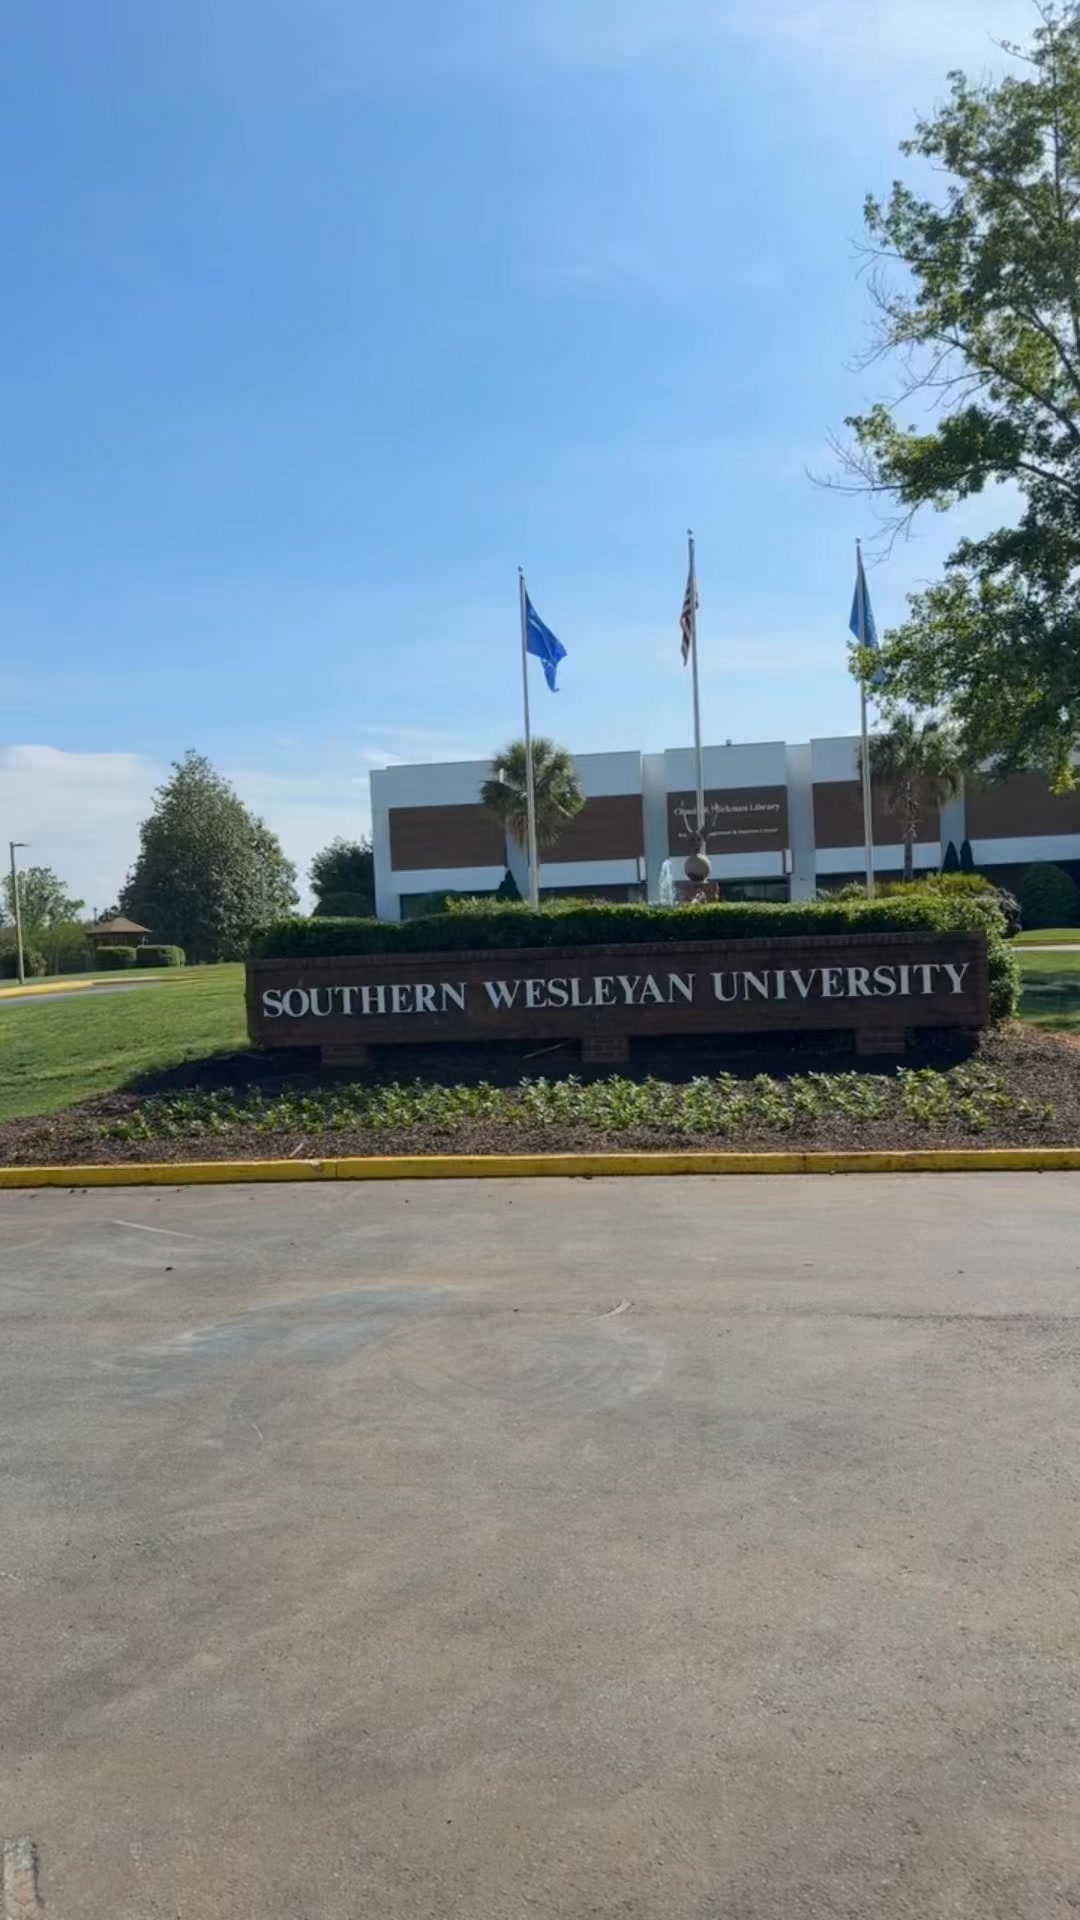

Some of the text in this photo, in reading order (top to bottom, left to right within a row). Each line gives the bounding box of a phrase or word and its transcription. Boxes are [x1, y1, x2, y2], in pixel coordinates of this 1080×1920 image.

[749, 802, 780, 813] Library
[262, 962, 970, 1018] SOUTHERN WESLEYAN UNIVERSITY
